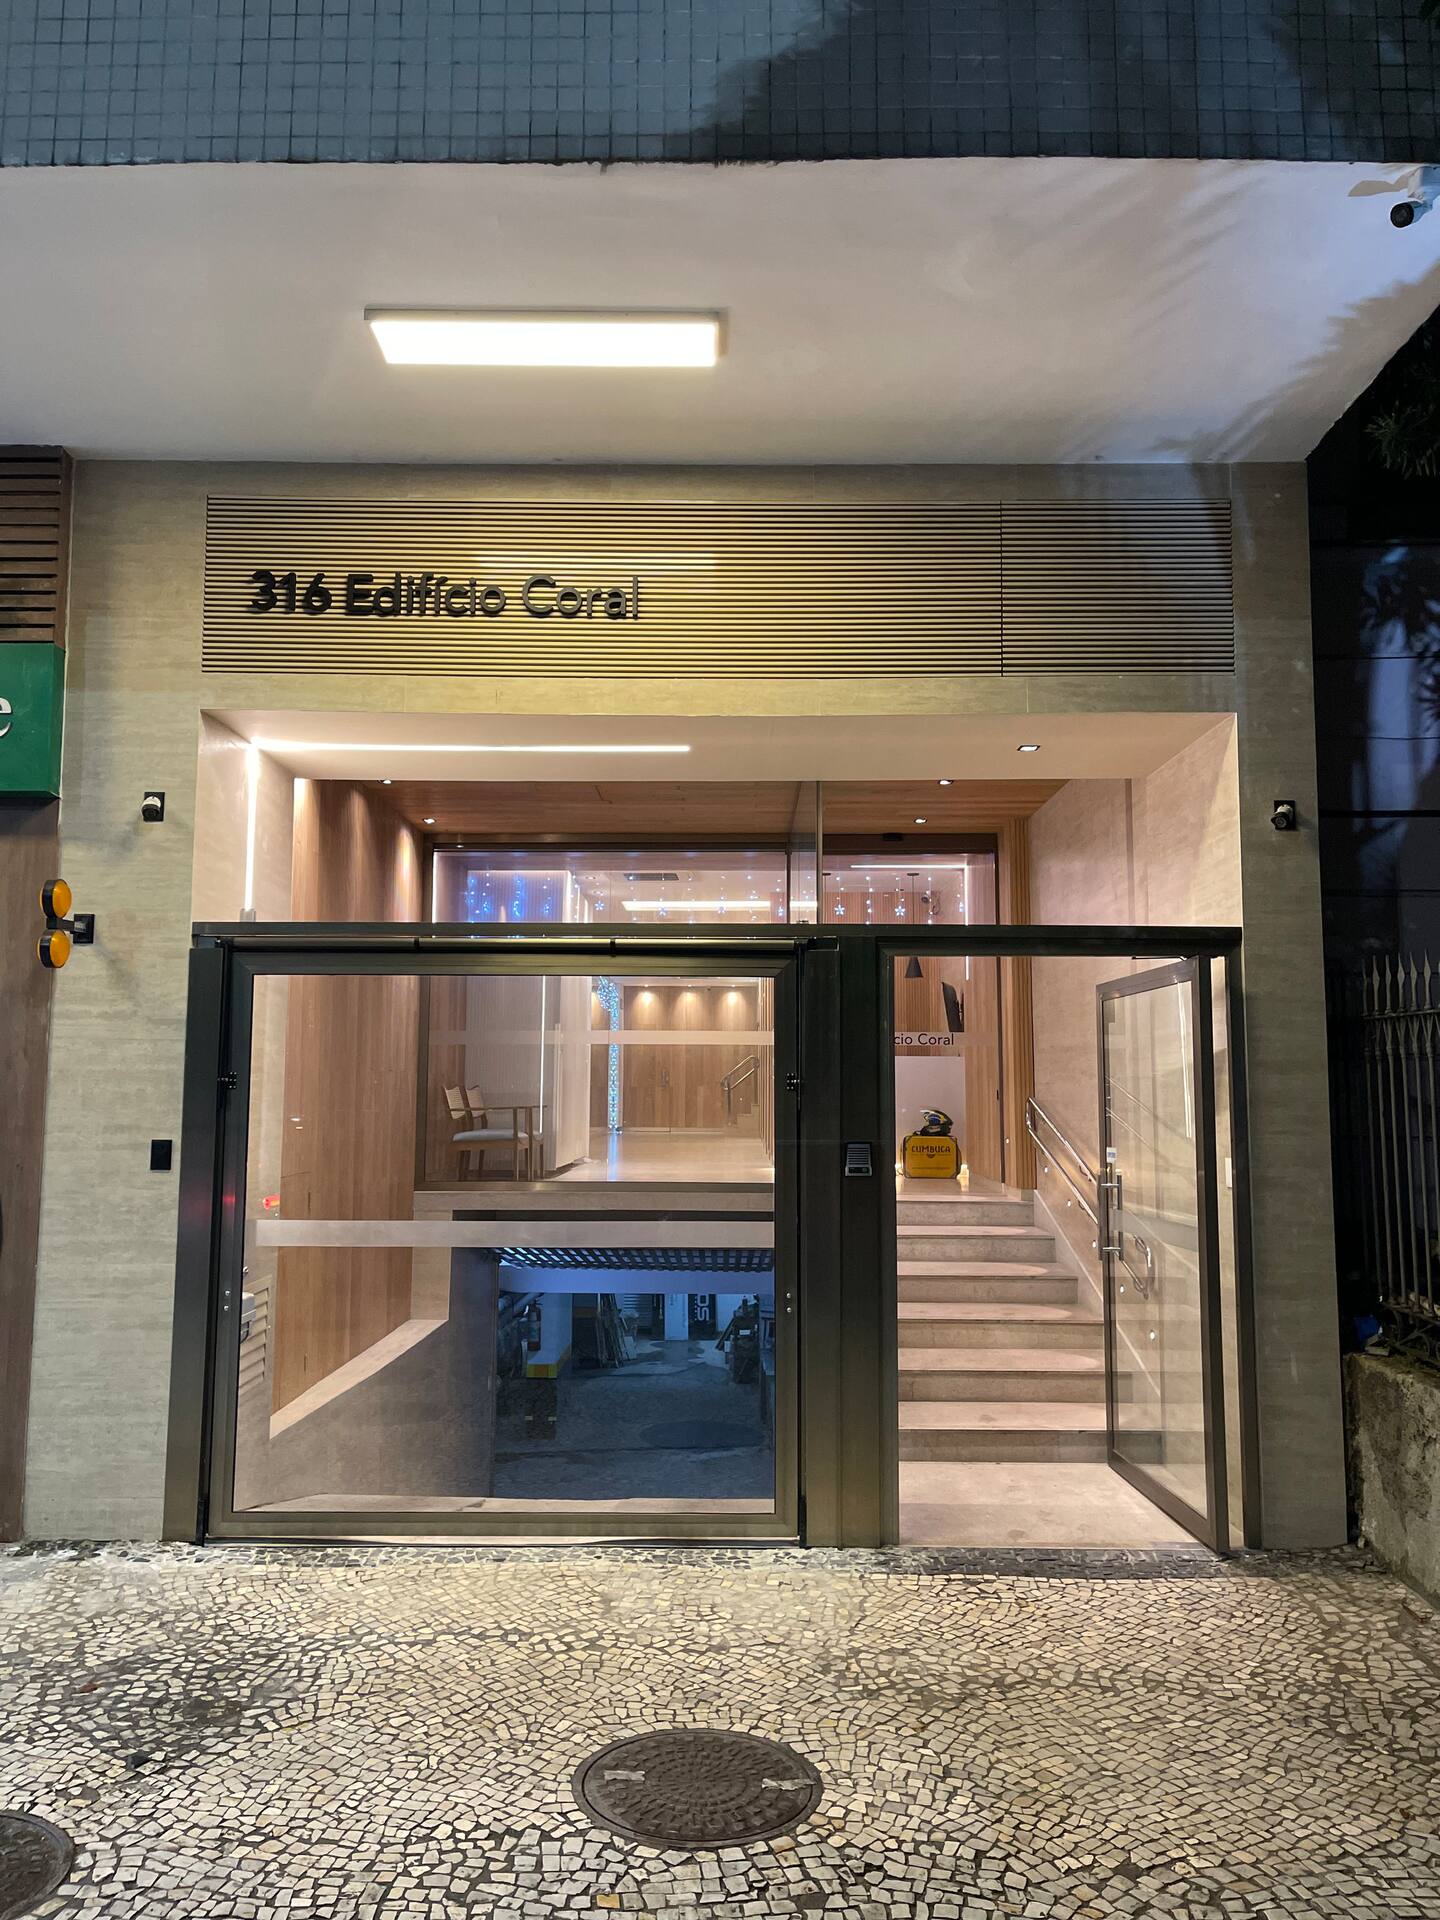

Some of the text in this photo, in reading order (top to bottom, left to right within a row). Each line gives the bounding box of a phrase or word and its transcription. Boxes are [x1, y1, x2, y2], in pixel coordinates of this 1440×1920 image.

[251, 569, 639, 619] 316 Edifício Coral
[917, 1032, 954, 1046] Coral
[911, 1145, 951, 1154] CUMBUCA
